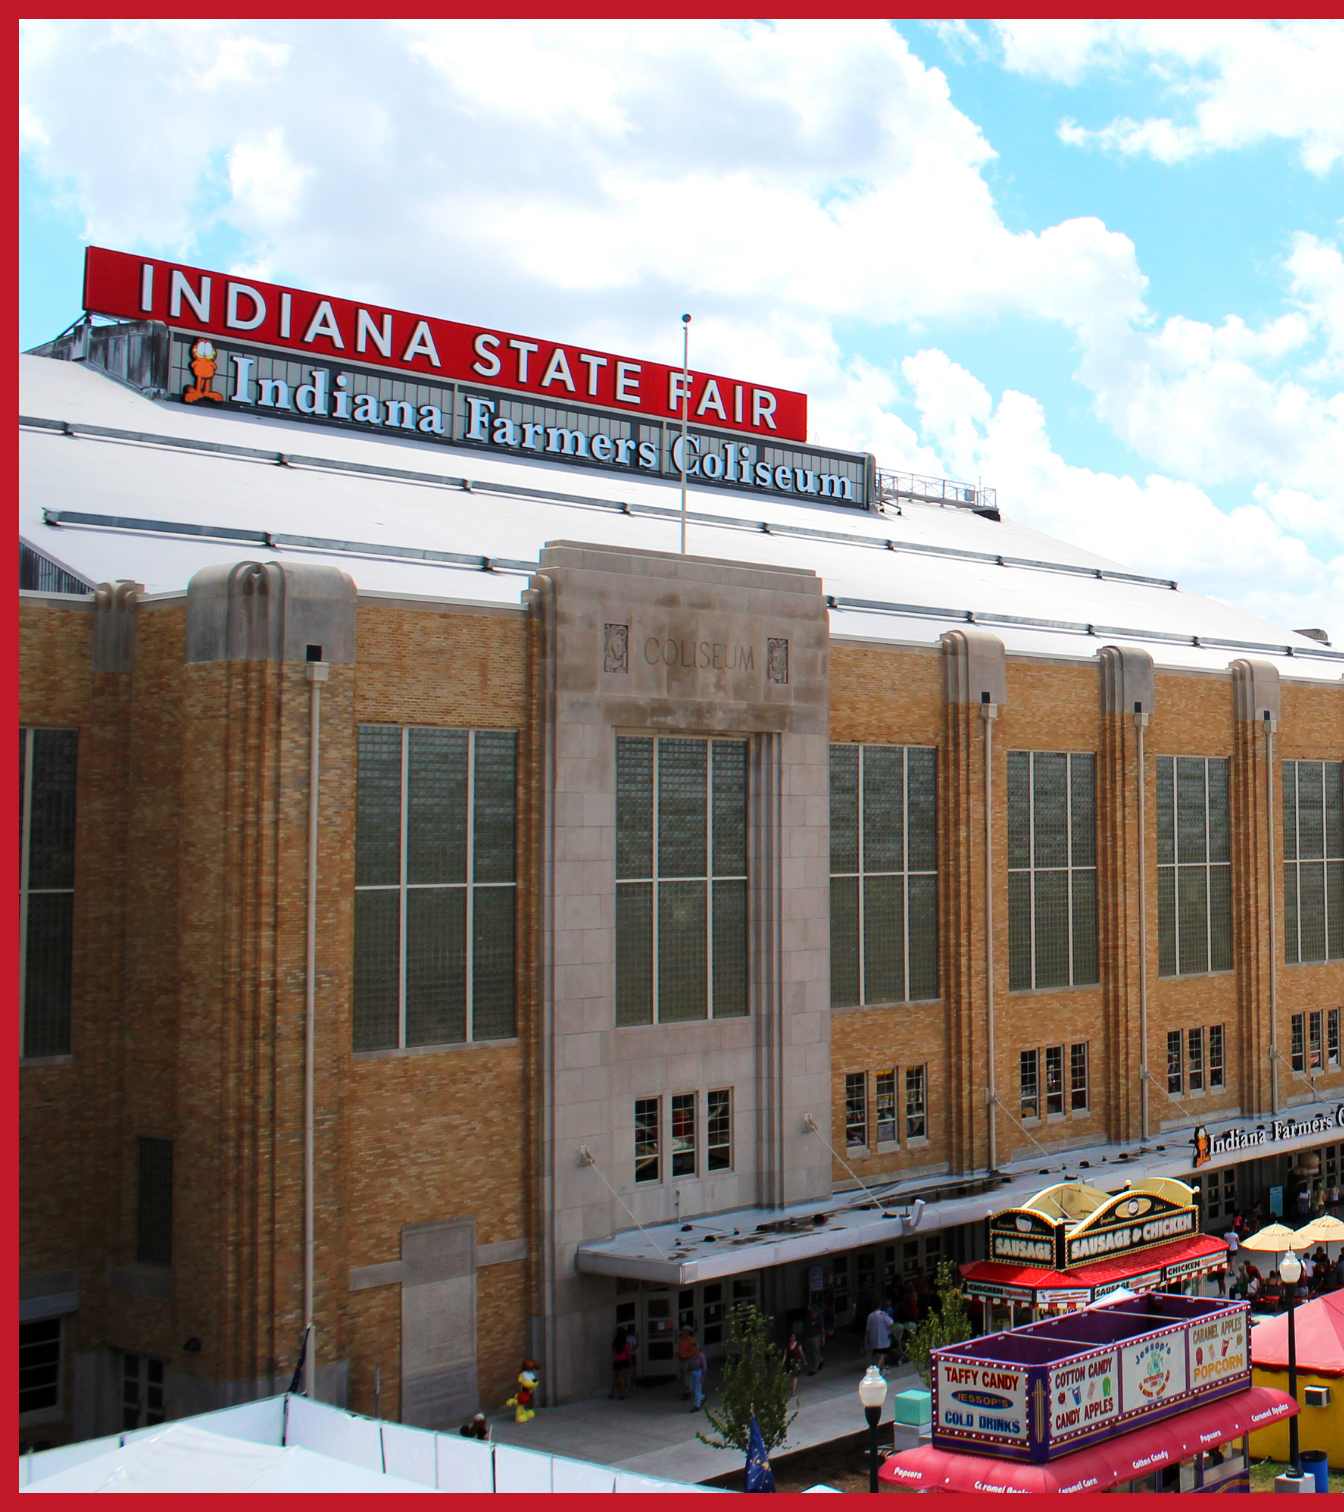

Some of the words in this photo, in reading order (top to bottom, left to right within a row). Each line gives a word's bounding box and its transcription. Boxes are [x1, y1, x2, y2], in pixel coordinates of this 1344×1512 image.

[141, 263, 442, 368] INDIANA
[472, 333, 642, 405] STATE
[668, 371, 778, 430] FAIR
[230, 355, 446, 435] Indiana
[465, 397, 657, 469] Farmers
[672, 433, 854, 501] Coliseum
[644, 637, 755, 672] COLISEUM
[1208, 1129, 1268, 1154] Indiana
[1272, 1115, 1333, 1141] Farmers
[994, 1237, 1052, 1260] SAUSAGE
[1070, 1231, 1131, 1260] SAUSAGE
[1142, 1214, 1193, 1242] CHICKEN
[1167, 1260, 1201, 1276] CHICKEN
[969, 1283, 1004, 1295] CHICKEN
[1192, 1324, 1219, 1345] CARAMEL
[1221, 1316, 1242, 1336] APPLES
[1135, 1341, 1172, 1366] Jessop's
[945, 1366, 979, 1386] TAFFY
[982, 1371, 1019, 1391] CANDY
[1055, 1365, 1086, 1389] COTTON
[1088, 1357, 1113, 1378] CANDY
[1193, 1353, 1244, 1382] POPCORN
[955, 1391, 1010, 1408] JESSOP'S
[944, 1410, 974, 1428] COLD
[979, 1414, 1021, 1434] DRINKS
[1055, 1409, 1081, 1430] CANDY
[1084, 1397, 1114, 1420] APPLES
[1251, 1409, 1271, 1423] Caramel
[1272, 1403, 1289, 1418] Apples
[1200, 1429, 1222, 1443] Popcorn
[1132, 1456, 1151, 1469] Cotton
[1151, 1450, 1169, 1463] Candy
[893, 1467, 923, 1479] Popcorn
[1083, 1477, 1098, 1488] Corn
